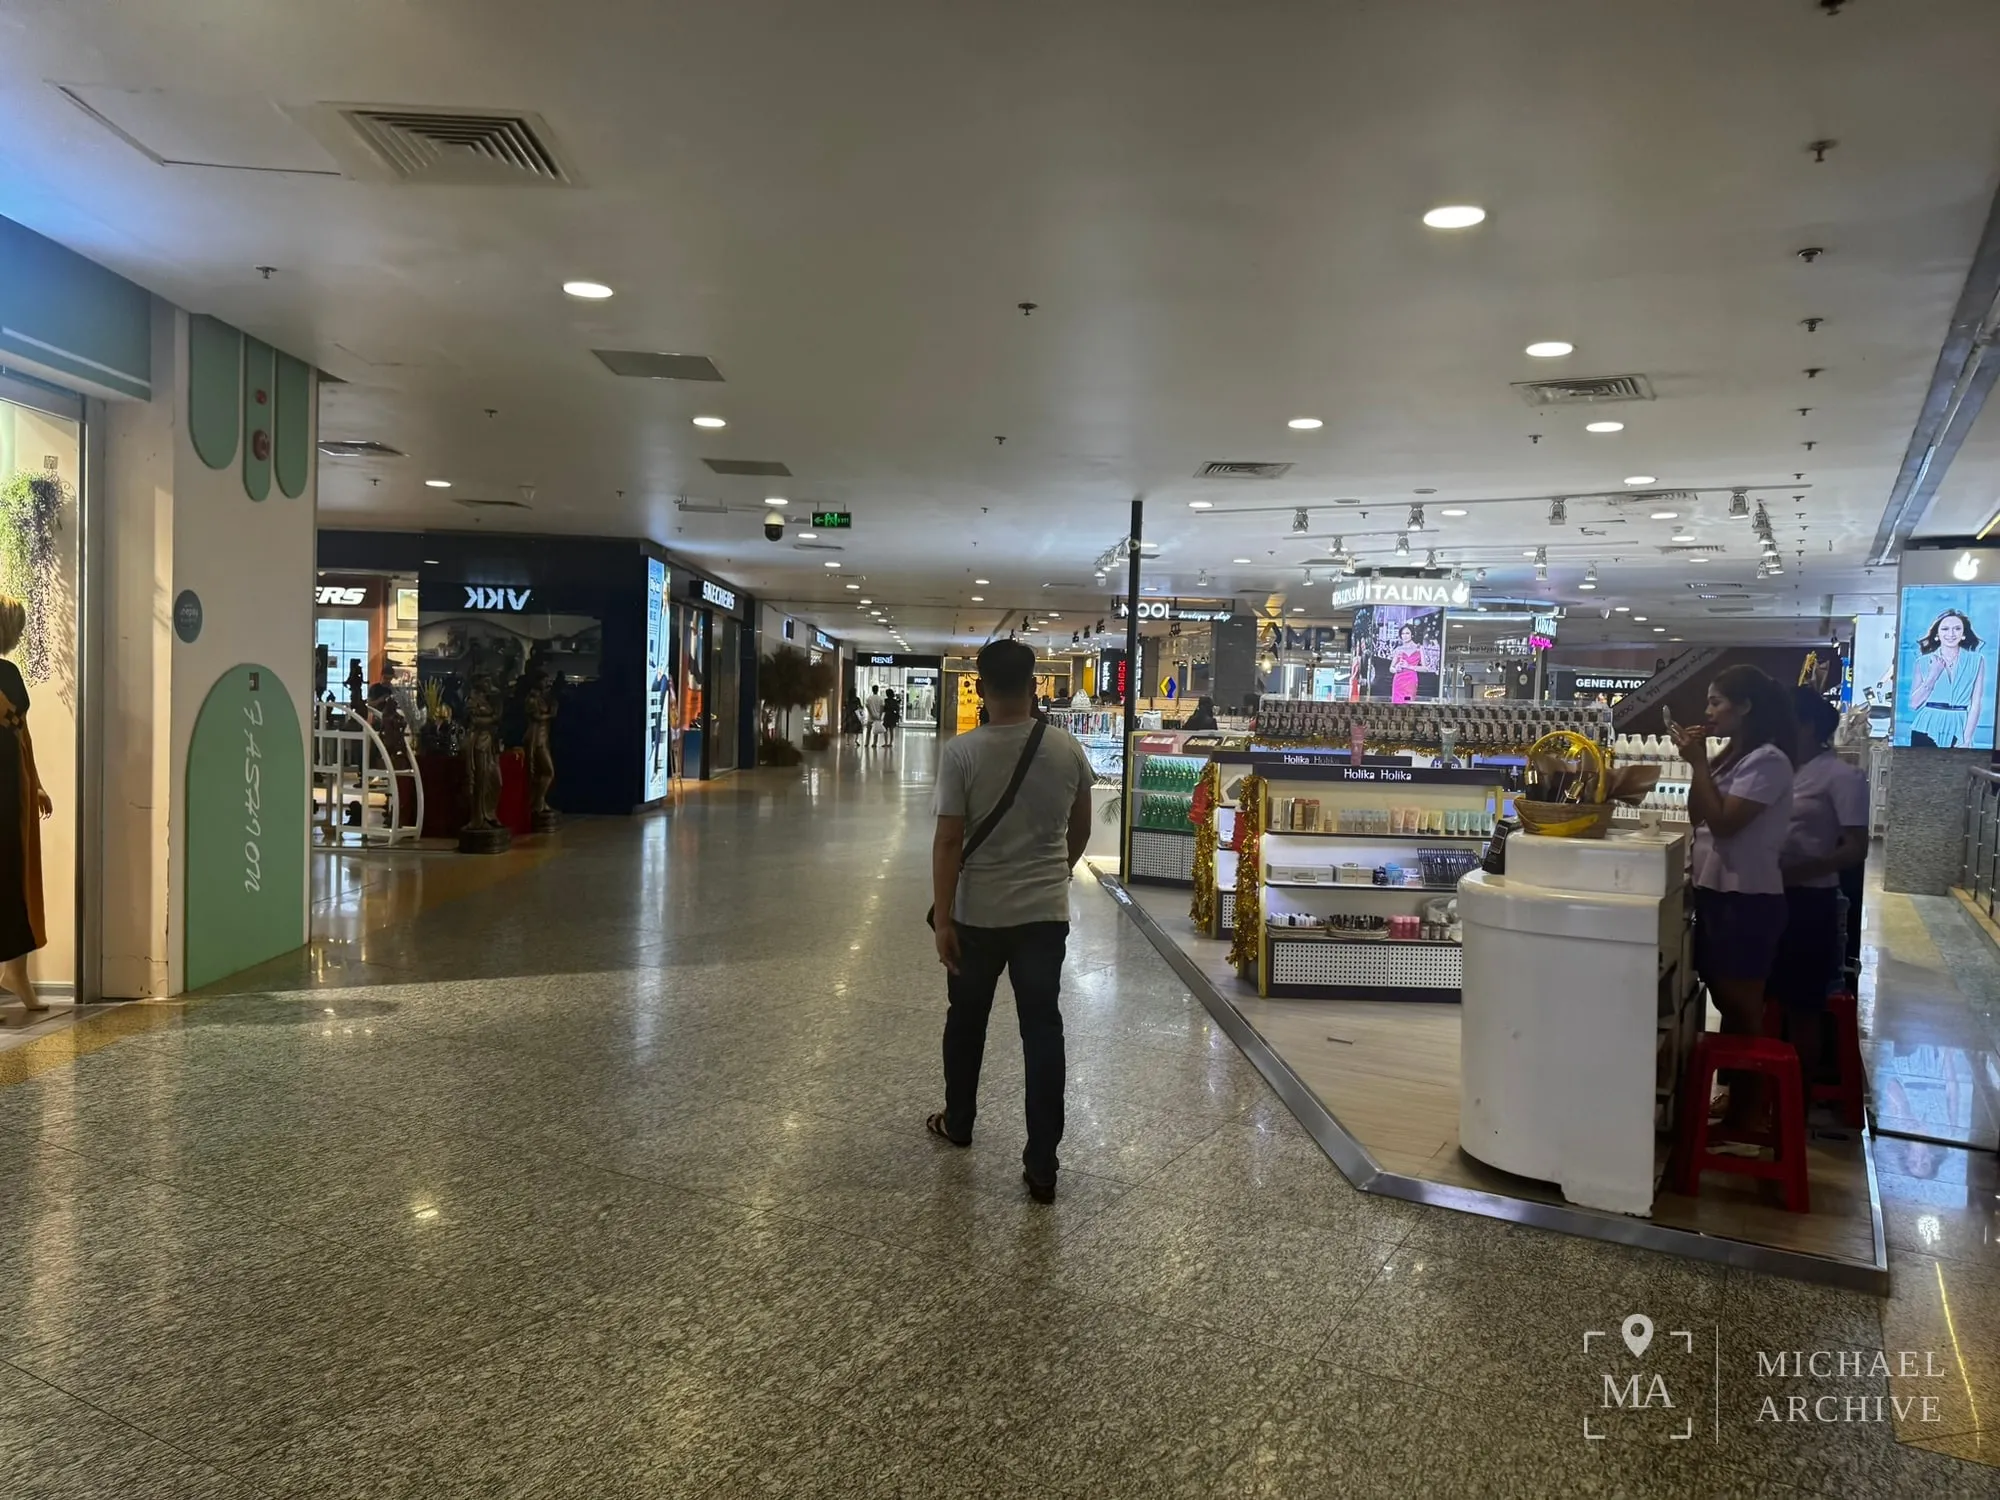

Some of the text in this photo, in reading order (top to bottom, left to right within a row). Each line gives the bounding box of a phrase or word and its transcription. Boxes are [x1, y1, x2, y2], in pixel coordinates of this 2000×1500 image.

[1365, 583, 1449, 603] ITALINA
[1283, 755, 1310, 766] Holika
[1344, 768, 1412, 781] Holika Holika
